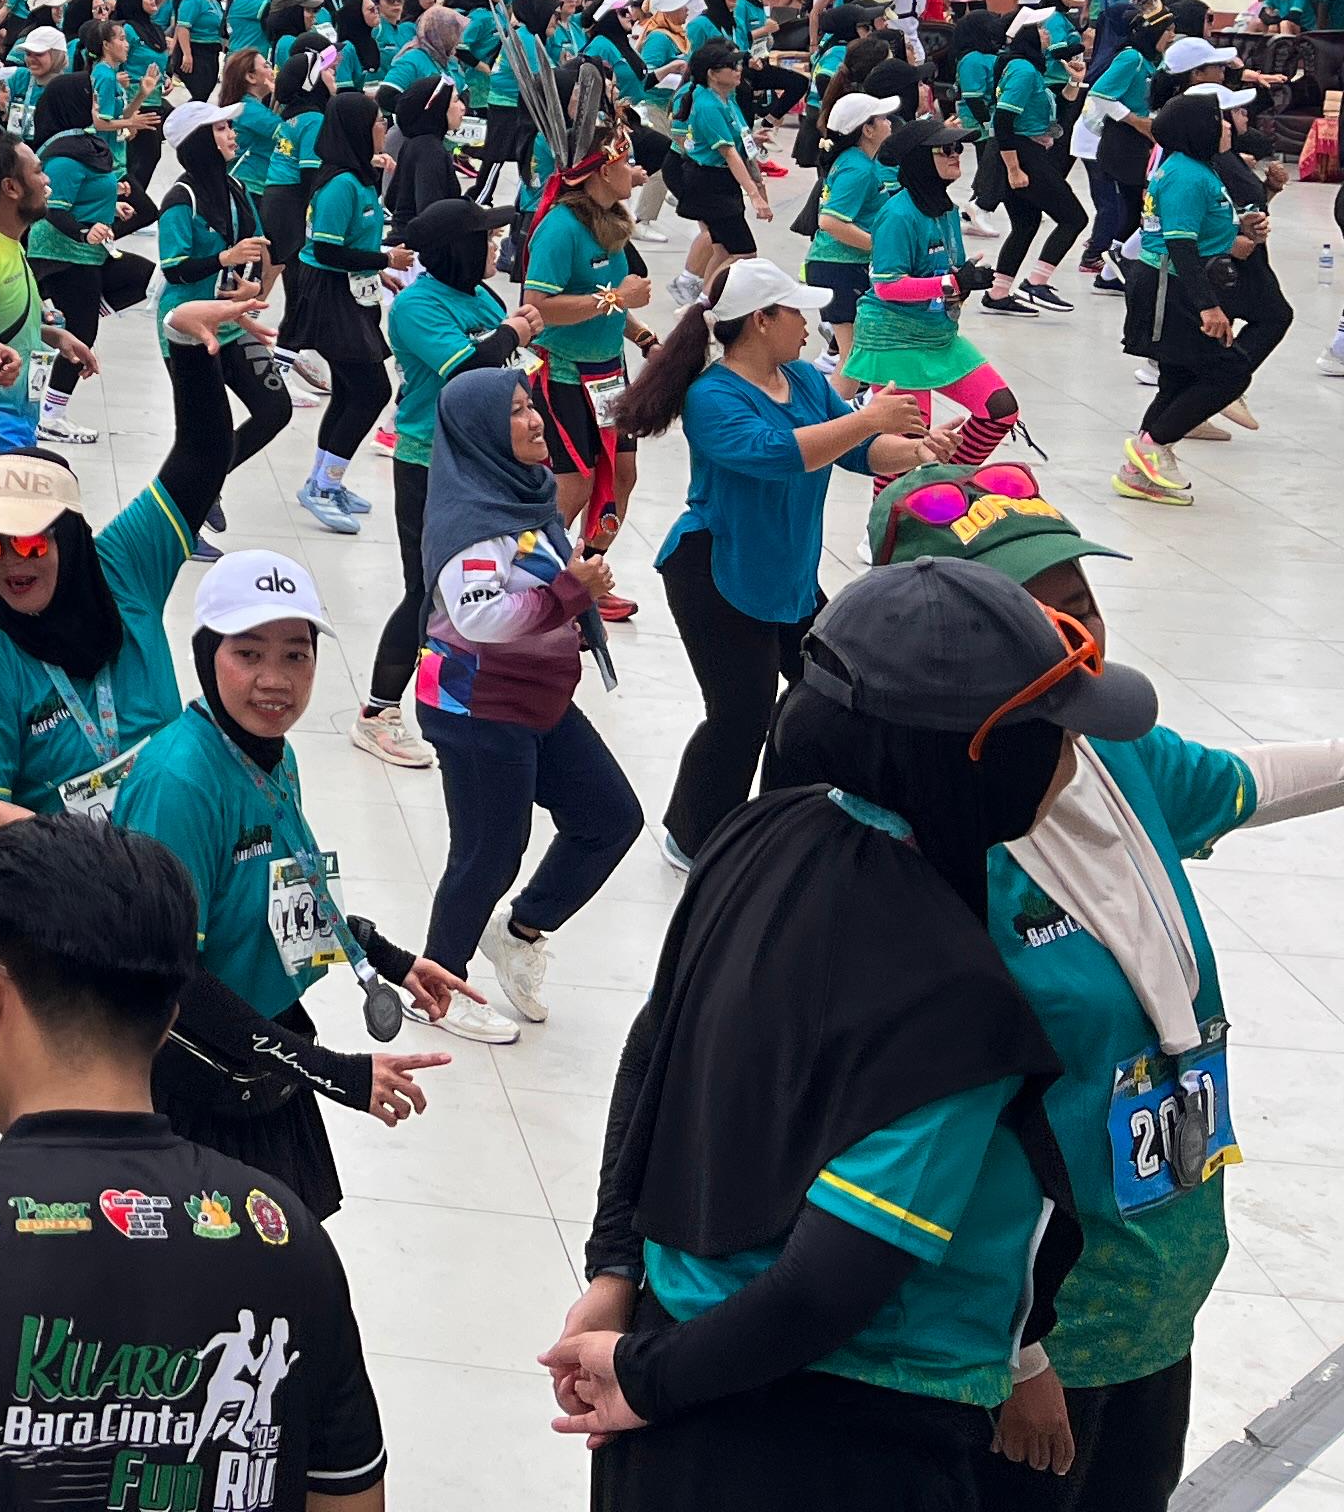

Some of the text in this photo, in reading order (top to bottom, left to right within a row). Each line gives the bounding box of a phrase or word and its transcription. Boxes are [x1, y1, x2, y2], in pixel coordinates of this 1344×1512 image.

[255, 567, 296, 594] alo
[1025, 919, 1069, 948] Bara
[1130, 1072, 1217, 1178] 201
[8, 1196, 91, 1219] Paser
[18, 1220, 90, 1230] TUNTAS
[2, 1402, 196, 1446] Bara Cinta
[250, 1424, 282, 1450] 202
[107, 1449, 205, 1512] Fun
